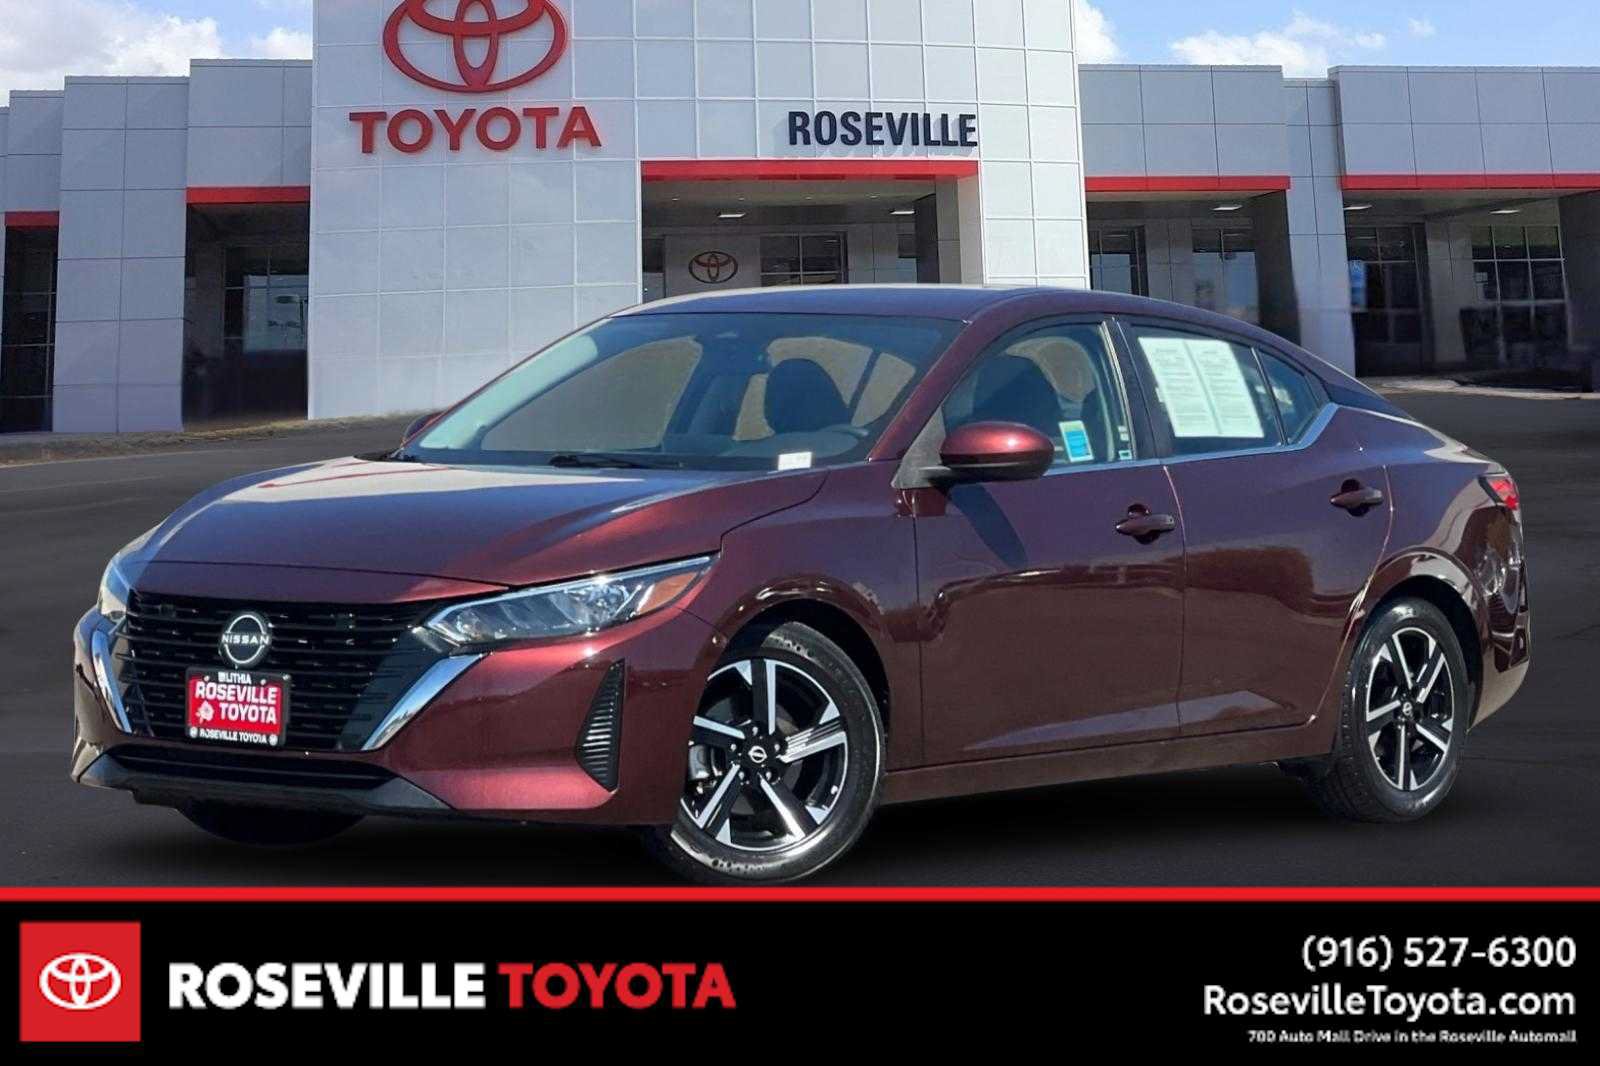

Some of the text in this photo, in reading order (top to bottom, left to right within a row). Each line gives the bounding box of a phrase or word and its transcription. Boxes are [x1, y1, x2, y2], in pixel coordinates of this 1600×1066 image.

[349, 106, 602, 154] TOYOTA
[788, 110, 978, 147] ROSEVILLE
[221, 634, 270, 645] NISSAN
[195, 681, 278, 705] ROSEVILLE
[219, 703, 278, 725] TOYOTA
[199, 729, 268, 744] ROSEVILLE TOYOTA
